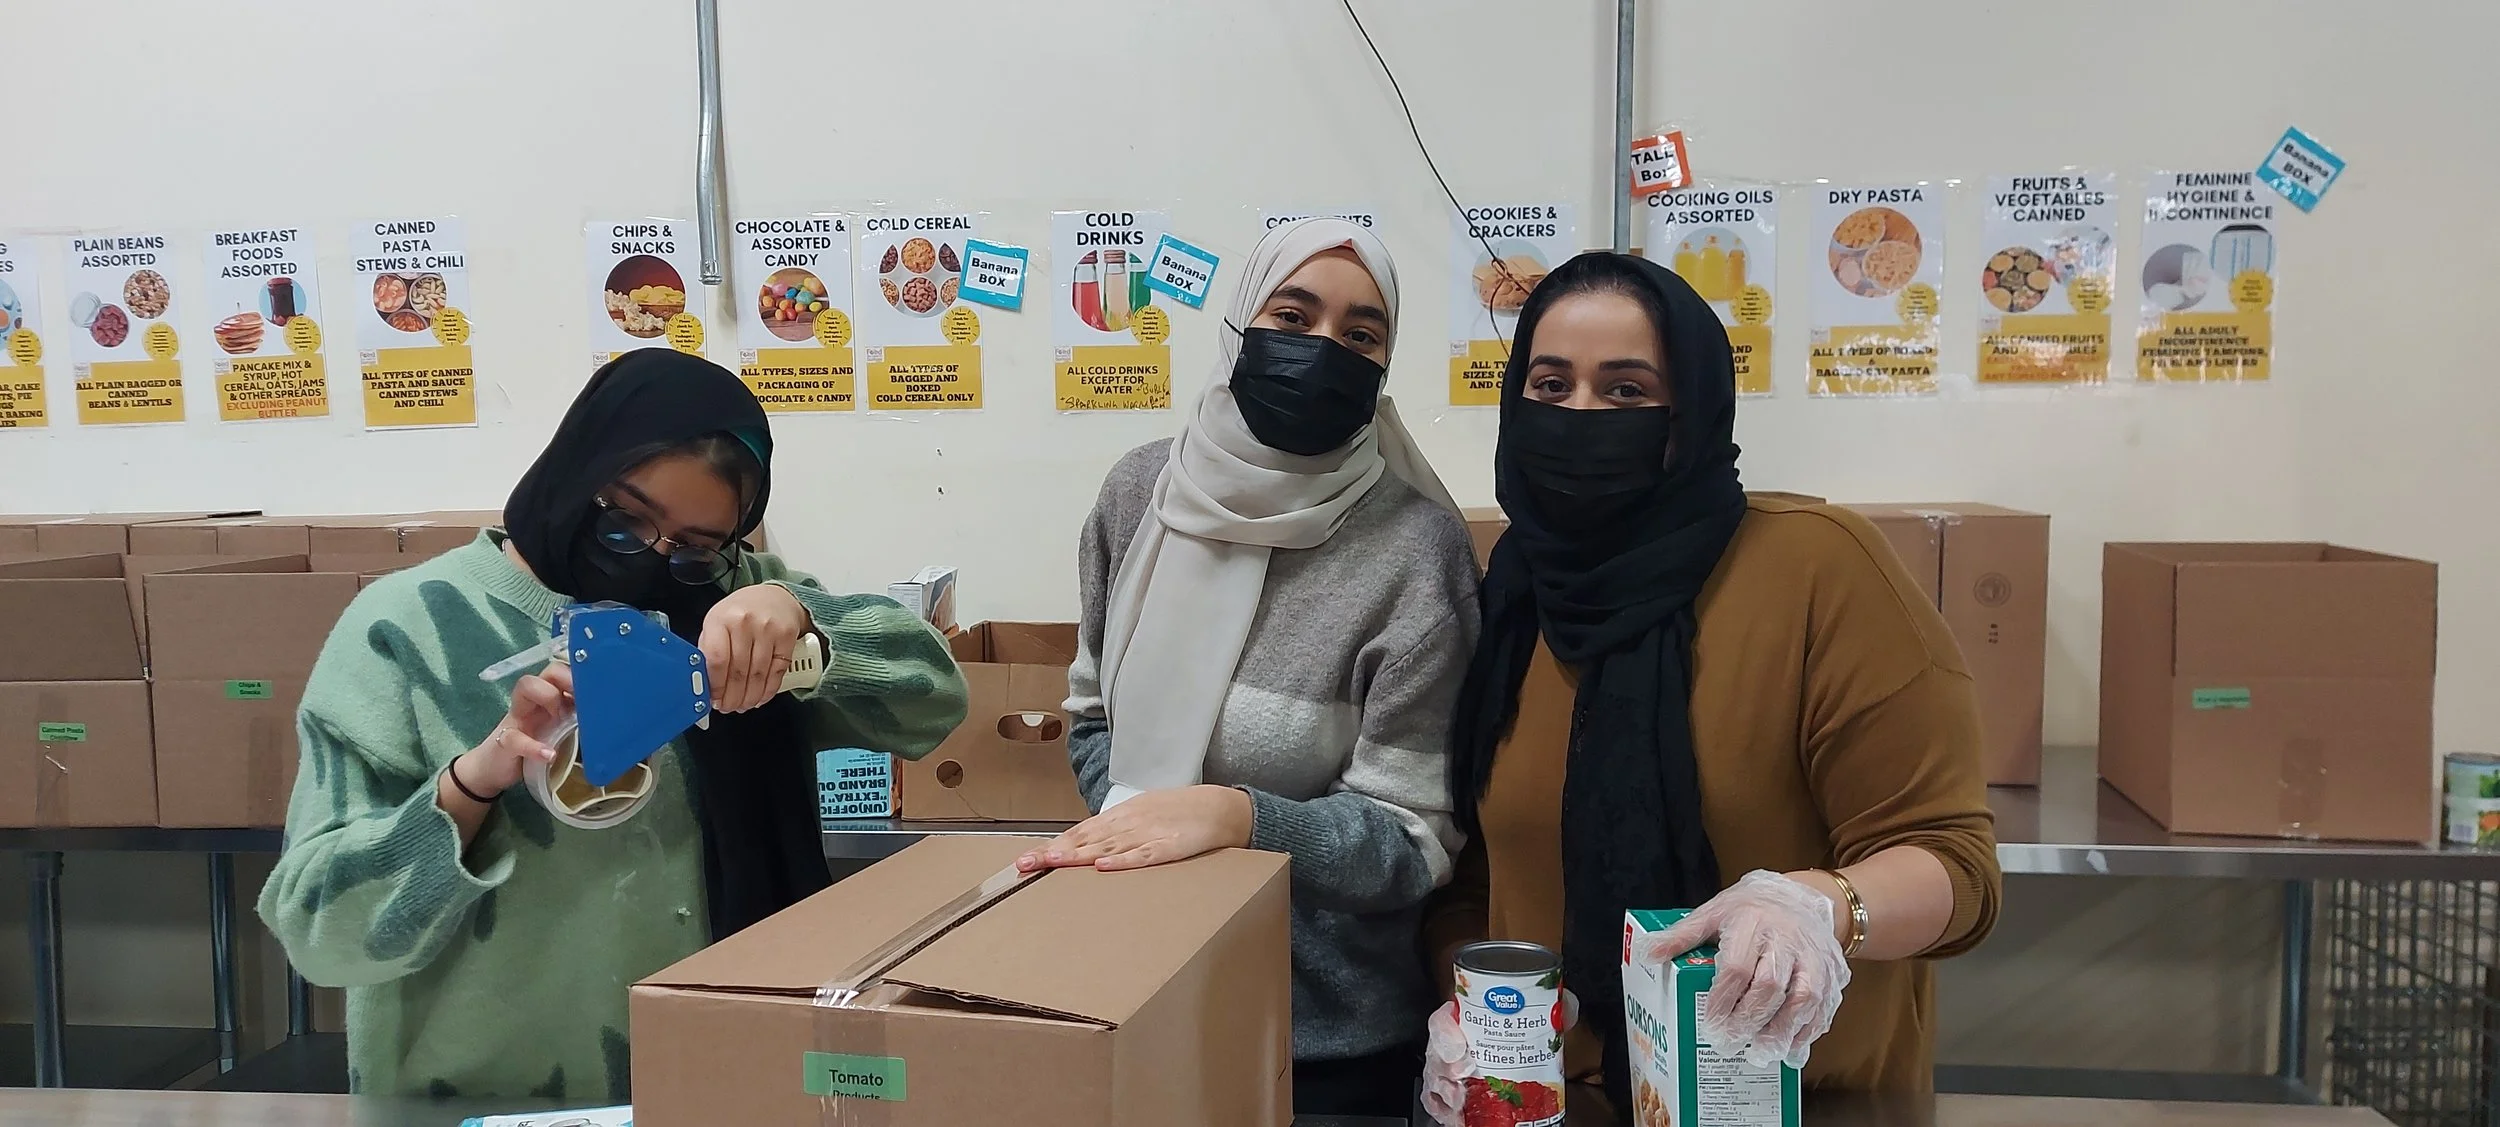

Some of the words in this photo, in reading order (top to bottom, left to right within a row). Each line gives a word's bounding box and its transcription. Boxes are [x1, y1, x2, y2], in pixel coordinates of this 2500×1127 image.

[1631, 150, 1673, 165] TALL
[2283, 143, 2328, 177] Banana
[2176, 172, 2252, 186] FEMININE
[2283, 162, 2312, 186] BOX
[2013, 177, 2071, 191] FRUITS
[2075, 177, 2087, 190] &
[1648, 192, 1729, 208] COOKING
[1735, 190, 1773, 205] OILS
[1830, 191, 1861, 204] DRY
[1868, 189, 1923, 203] PASTA
[1995, 191, 2105, 207] VEGETABLES
[2167, 190, 2239, 204] HYGIENE
[2244, 190, 2255, 202] &
[1086, 213, 1134, 227] COLD
[1467, 207, 1542, 221] COOKIES
[1547, 207, 1557, 219] &
[1666, 208, 1754, 225] ASSORTED
[2013, 208, 2085, 222] CANNED
[375, 221, 436, 235] CANNED
[735, 220, 830, 234] CHOCOLATE
[835, 220, 845, 232] &
[867, 218, 909, 231] COLD
[914, 217, 971, 230] CEREAL
[613, 225, 658, 237] CHIPS
[663, 225, 672, 237] &
[1469, 224, 1556, 238] CRACKERS
[74, 239, 114, 251] PLAIN
[119, 236, 164, 250] BEANS
[215, 229, 297, 246] BREAKFAST
[752, 237, 831, 250] ASSORTED
[1077, 231, 1144, 246] DRINKS
[383, 240, 431, 253] PASTA
[611, 242, 675, 254] SNACKS
[232, 247, 283, 261] FOODS
[765, 254, 819, 266] CANDY
[81, 253, 155, 268] ASSORTED
[356, 258, 406, 271] STEWS
[411, 257, 421, 269] &
[426, 255, 464, 268] CHILI
[972, 257, 1019, 275] Banana
[221, 262, 297, 278] ASSORTED
[1161, 255, 1207, 282] Banana
[979, 273, 1005, 287] BOX
[1165, 272, 1194, 291] BOX
[1813, 348, 1834, 356] ALL
[233, 362, 280, 372] PANCAKE
[283, 361, 301, 370] MIX
[304, 360, 311, 368] &
[889, 365, 909, 373] ALL
[1067, 366, 1087, 375] ALL
[1088, 366, 1116, 375] COLD
[1119, 365, 1158, 374] DRINKS
[1471, 361, 1491, 369] ALL
[243, 372, 280, 382] SYRUP,
[282, 371, 302, 379] HOT
[362, 372, 380, 380] ALL
[383, 371, 414, 379] TYPES
[416, 370, 429, 378] OF
[431, 368, 473, 377] CANNED
[741, 368, 760, 376] ALL
[762, 368, 797, 376] TYPES,
[799, 367, 828, 375] SIZES
[831, 367, 853, 375] AND
[1463, 371, 1495, 379] SIZES
[1891, 367, 1930, 376] PASTA
[371, 380, 405, 389] PASTA
[408, 379, 430, 387] AND
[432, 378, 465, 387] SAUCE
[935, 374, 958, 382] AND
[1081, 376, 1121, 385] EXCEPT
[1123, 376, 1144, 384] FOR
[76, 382, 94, 391] ALL
[96, 381, 124, 390] PLAIN
[127, 380, 166, 388] BAGGED
[169, 379, 182, 387] OR
[224, 382, 264, 392] CEREAL,
[267, 381, 297, 390] OATS,
[299, 379, 325, 388] JAMS
[758, 381, 819, 389] PACKAGING
[906, 384, 941, 392] BOXED
[1094, 385, 1132, 394] WATER
[1470, 381, 1493, 389] AND
[108, 390, 148, 398] CANNED
[230, 393, 237, 401] &
[239, 391, 272, 400] OTHER
[275, 389, 321, 398] SPREADS
[379, 390, 420, 399] CANNED
[423, 389, 458, 397] STEWS
[755, 395, 805, 403] OCOLATE
[816, 394, 851, 402] CANDY
[876, 394, 903, 402] COLD
[905, 394, 944, 402] CEREAL
[947, 393, 975, 401] ONLY
[88, 400, 120, 408] BEANS
[131, 398, 172, 407] LENTILS
[227, 400, 284, 410] EXCLUDING
[286, 398, 326, 407] PEANUT
[394, 400, 415, 408] AND
[418, 399, 444, 407] CHILI
[6, 410, 43, 418] BAKING
[259, 409, 297, 417] BUTTER
[836, 766, 886, 778] THERE.
[839, 778, 886, 789] BRAND
[1488, 992, 1518, 1003] Great
[1465, 1011, 1499, 1029] Garlic
[1503, 1019, 1513, 1029] &
[1517, 1015, 1547, 1029] Herb
[1627, 994, 1668, 1053] OURSONS
[1484, 1028, 1502, 1037] Pasta
[1476, 1040, 1495, 1049] Sauce
[1516, 1044, 1535, 1052] pâtes
[1470, 1050, 1480, 1060] et
[1484, 1050, 1515, 1064] fines
[1519, 1050, 1556, 1064] herbes
[829, 1069, 883, 1086] Tomato
